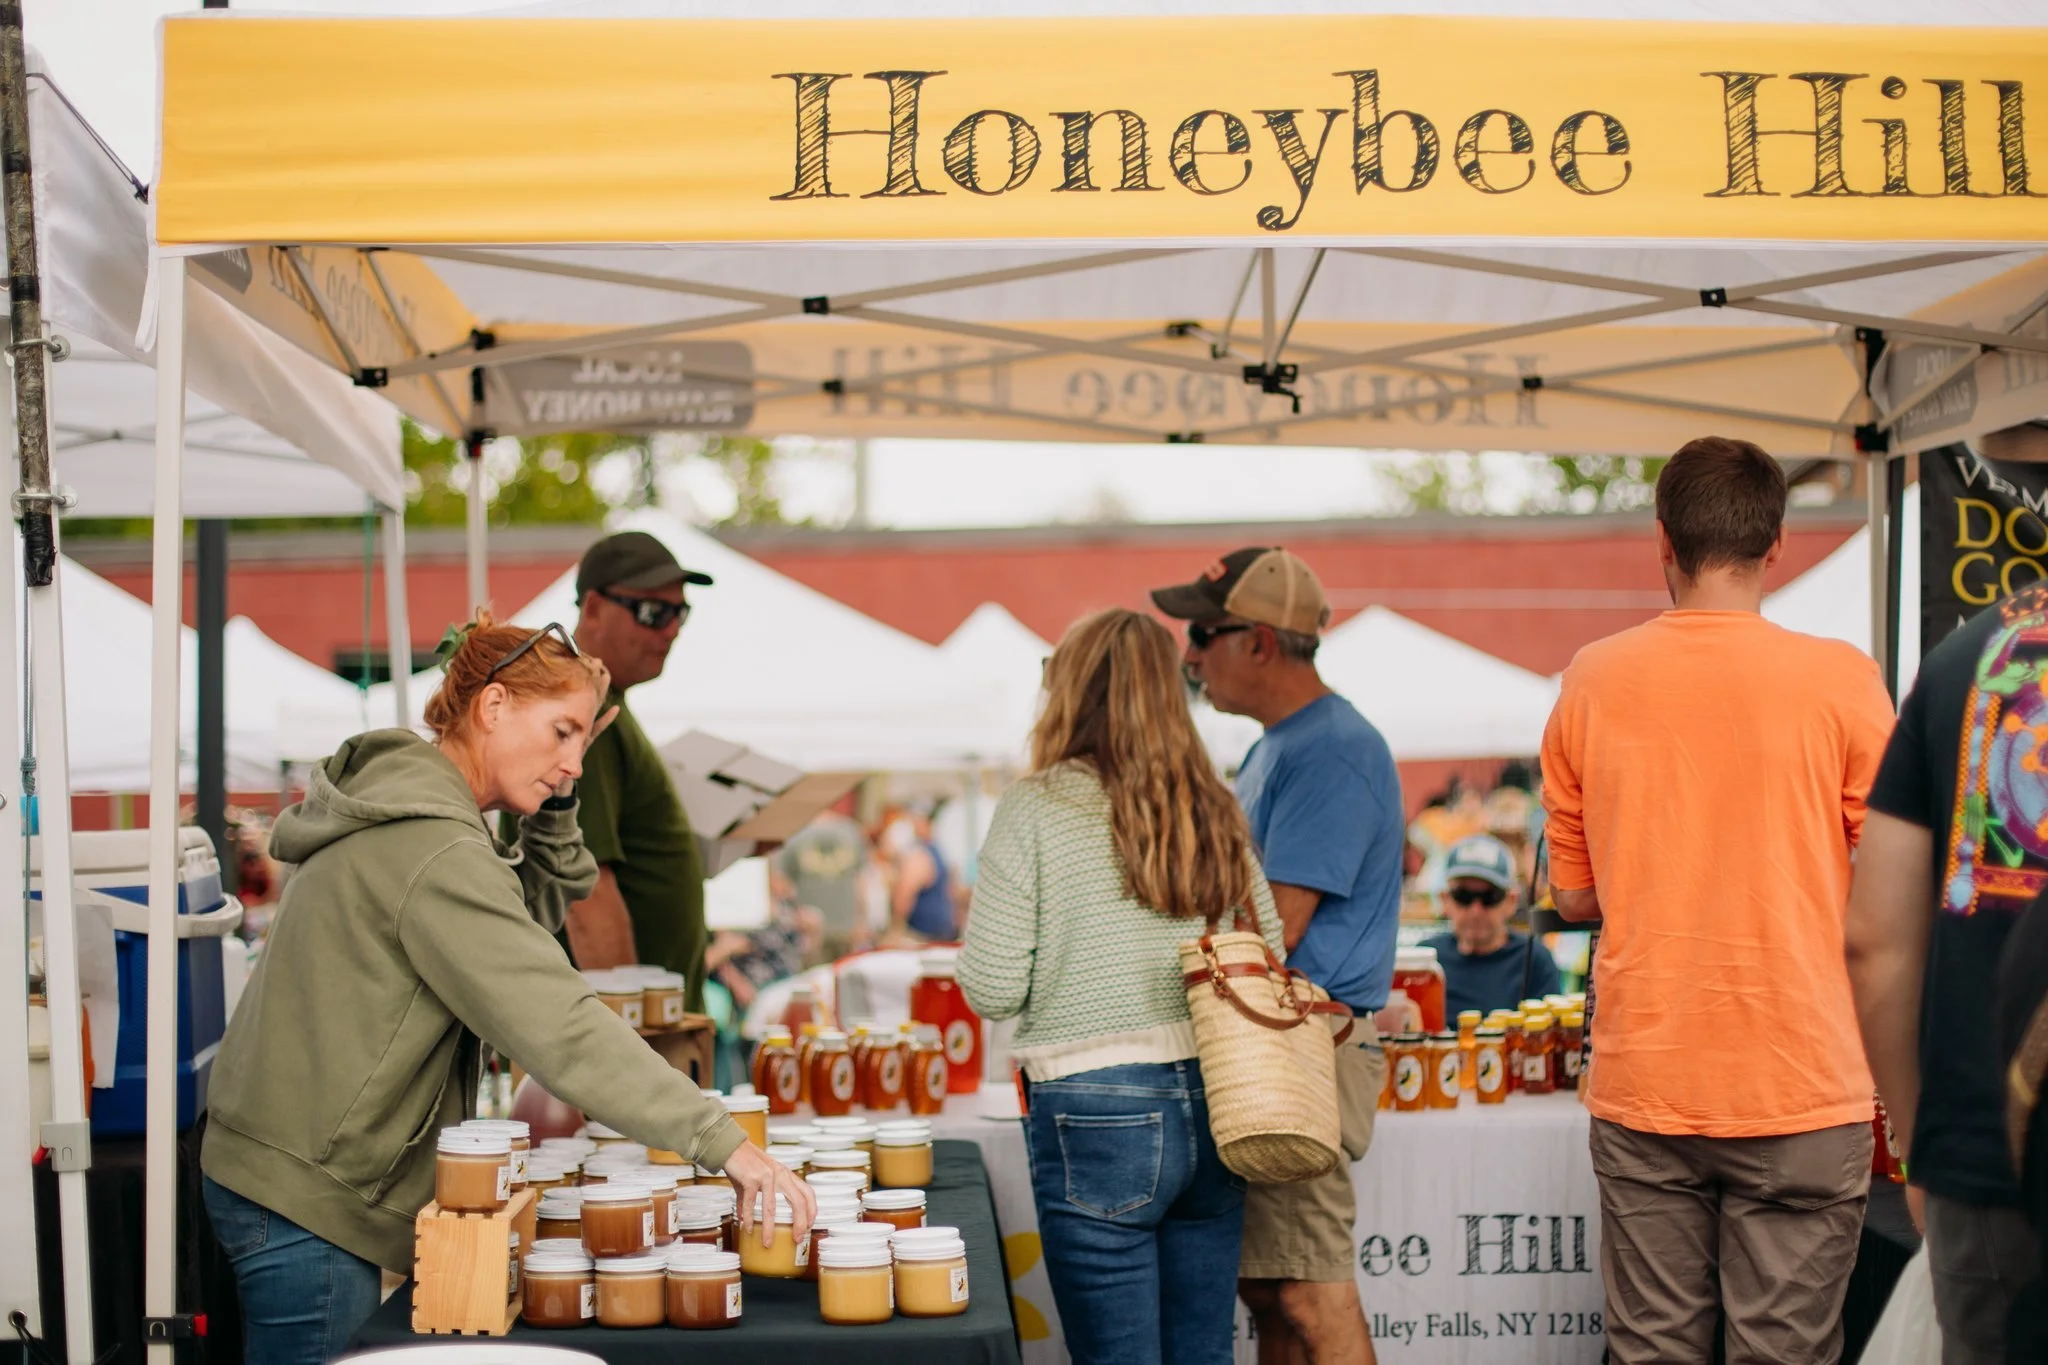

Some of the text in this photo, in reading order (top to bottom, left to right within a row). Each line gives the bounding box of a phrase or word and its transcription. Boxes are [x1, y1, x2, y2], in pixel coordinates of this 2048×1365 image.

[770, 68, 2048, 231] Honeybee Hill
[1457, 1213, 1593, 1277] Hill
[1368, 1311, 1607, 1346] lley Falls, NY 1218
